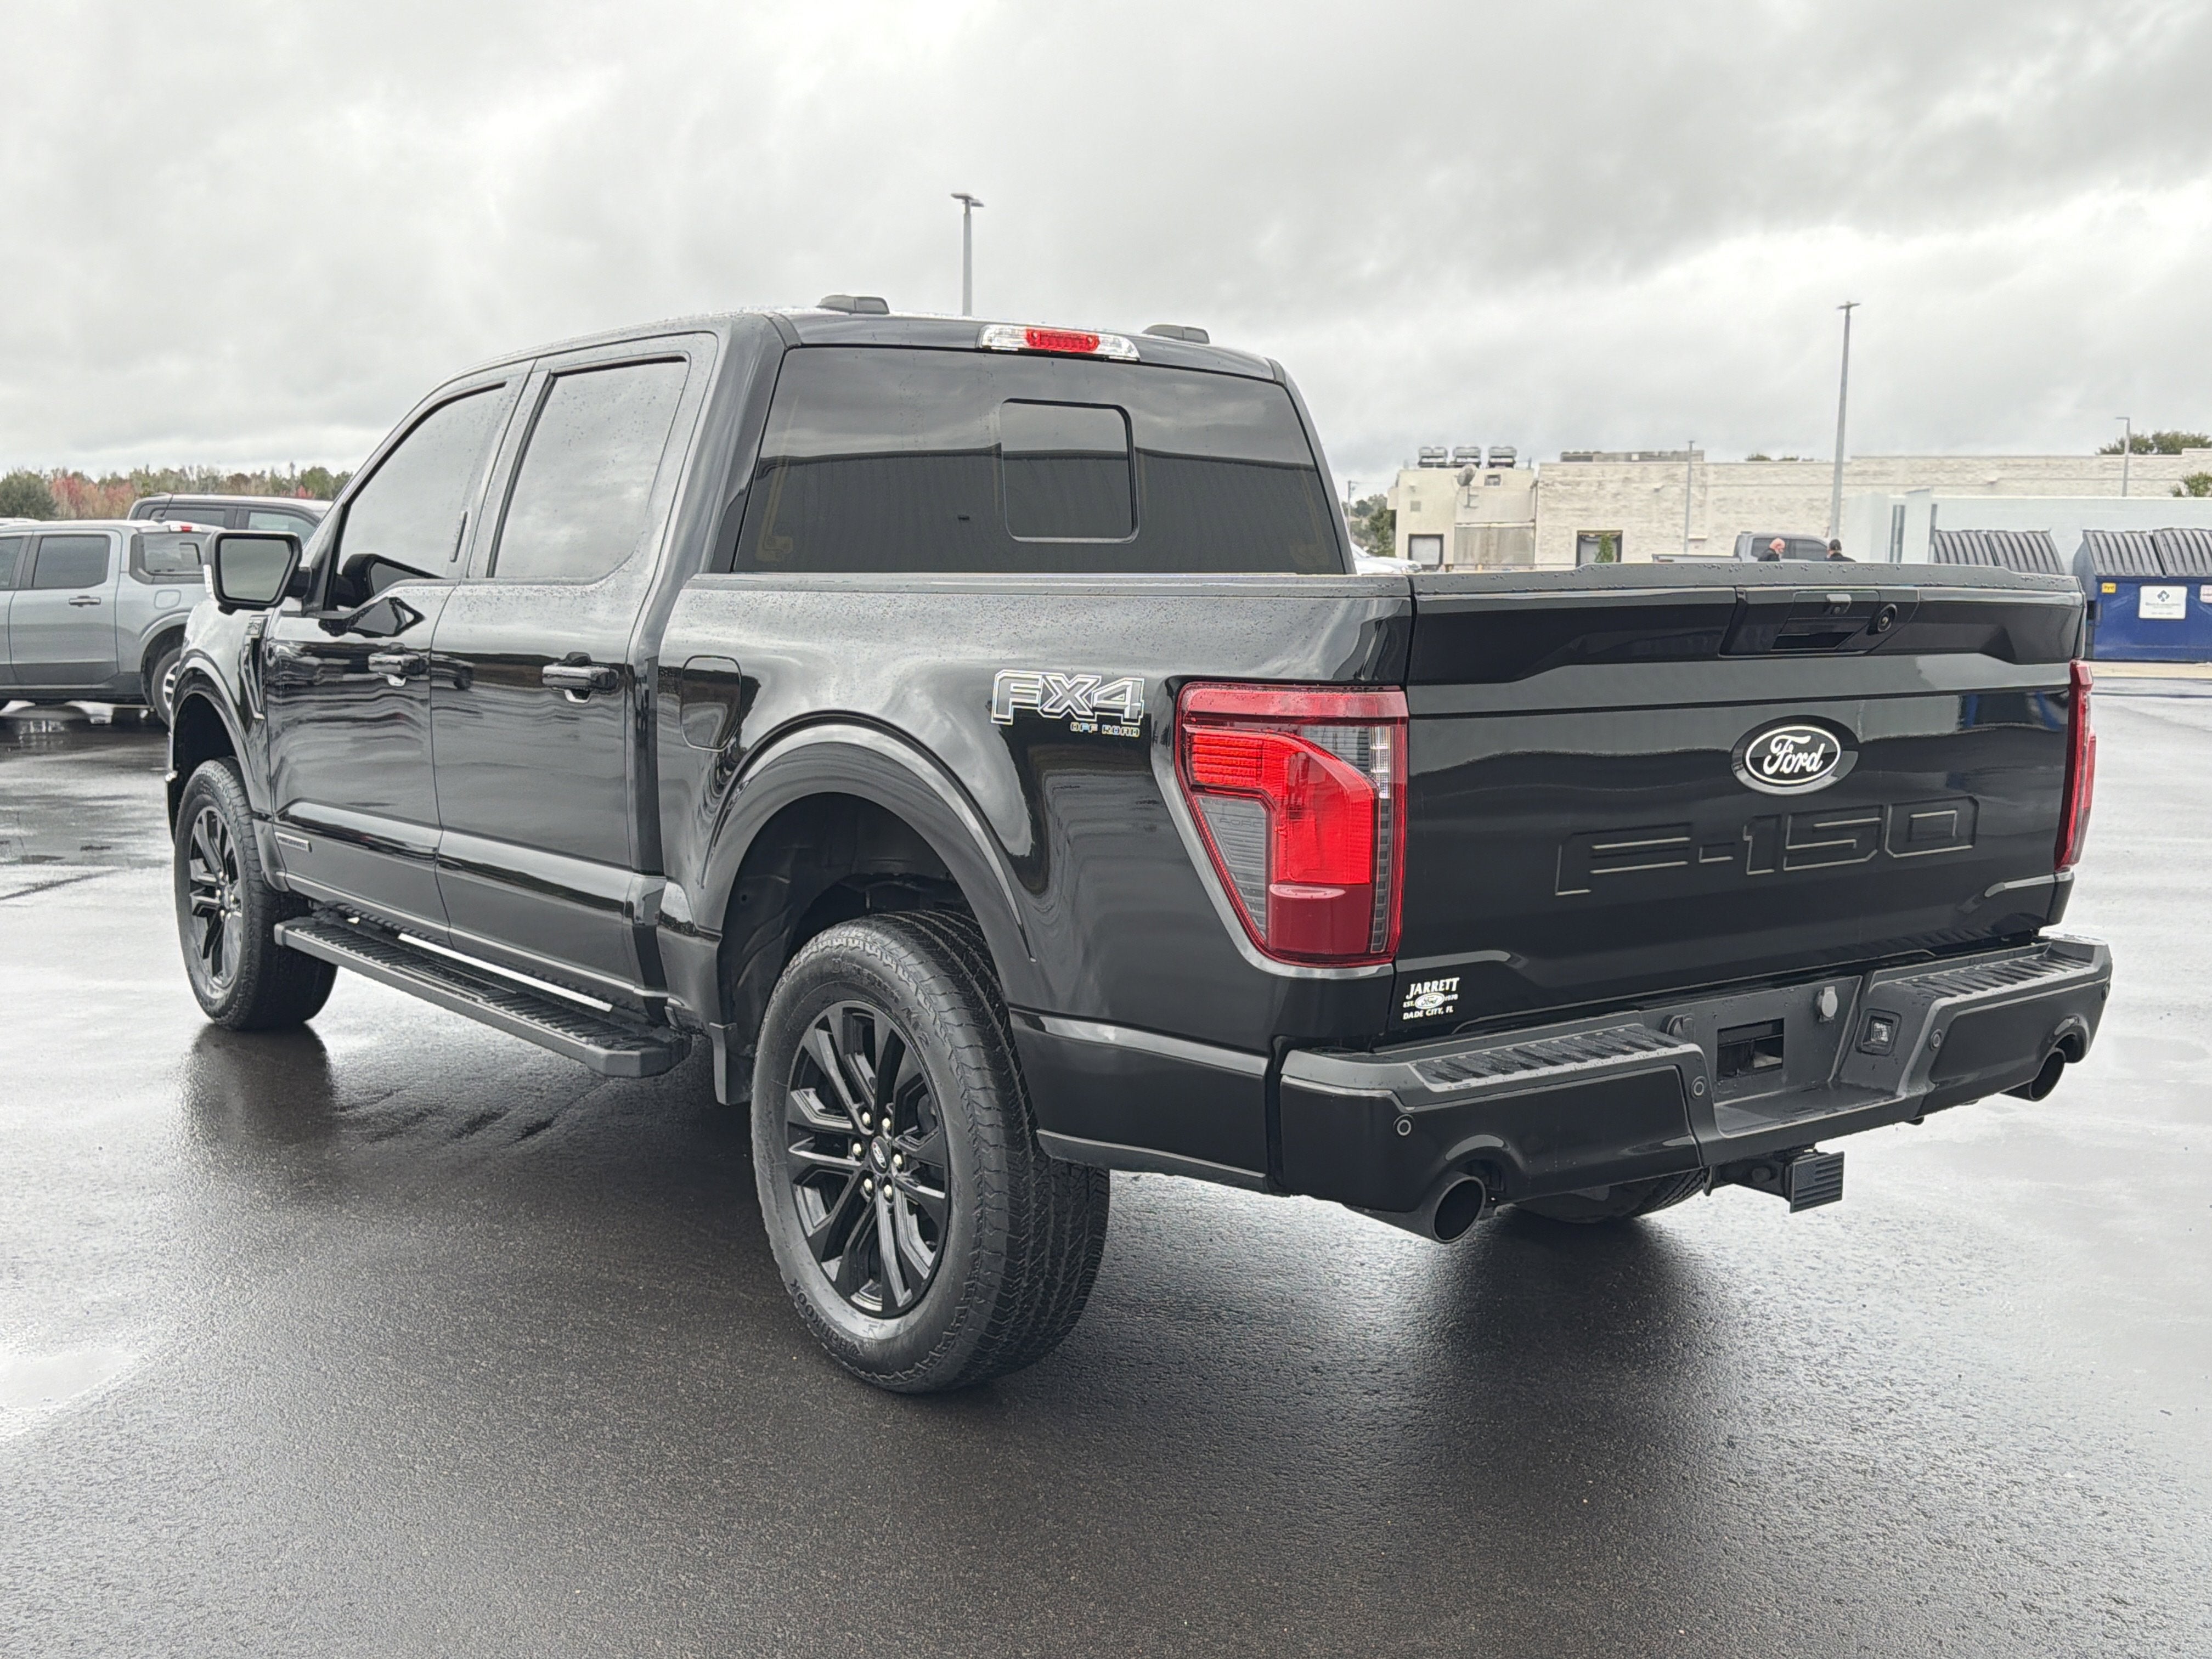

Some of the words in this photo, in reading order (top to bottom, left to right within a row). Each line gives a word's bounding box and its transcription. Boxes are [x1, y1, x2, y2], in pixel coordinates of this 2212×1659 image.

[991, 669, 1144, 725] FX4
[1070, 722, 1098, 733] OFF
[1102, 724, 1140, 737] ROAD
[1763, 734, 1825, 775] Ford
[1555, 795, 1979, 895] F-150
[1406, 977, 1460, 1000] JARRETT
[1403, 1010, 1424, 1020] DADE
[1425, 1007, 1444, 1017] CITY,
